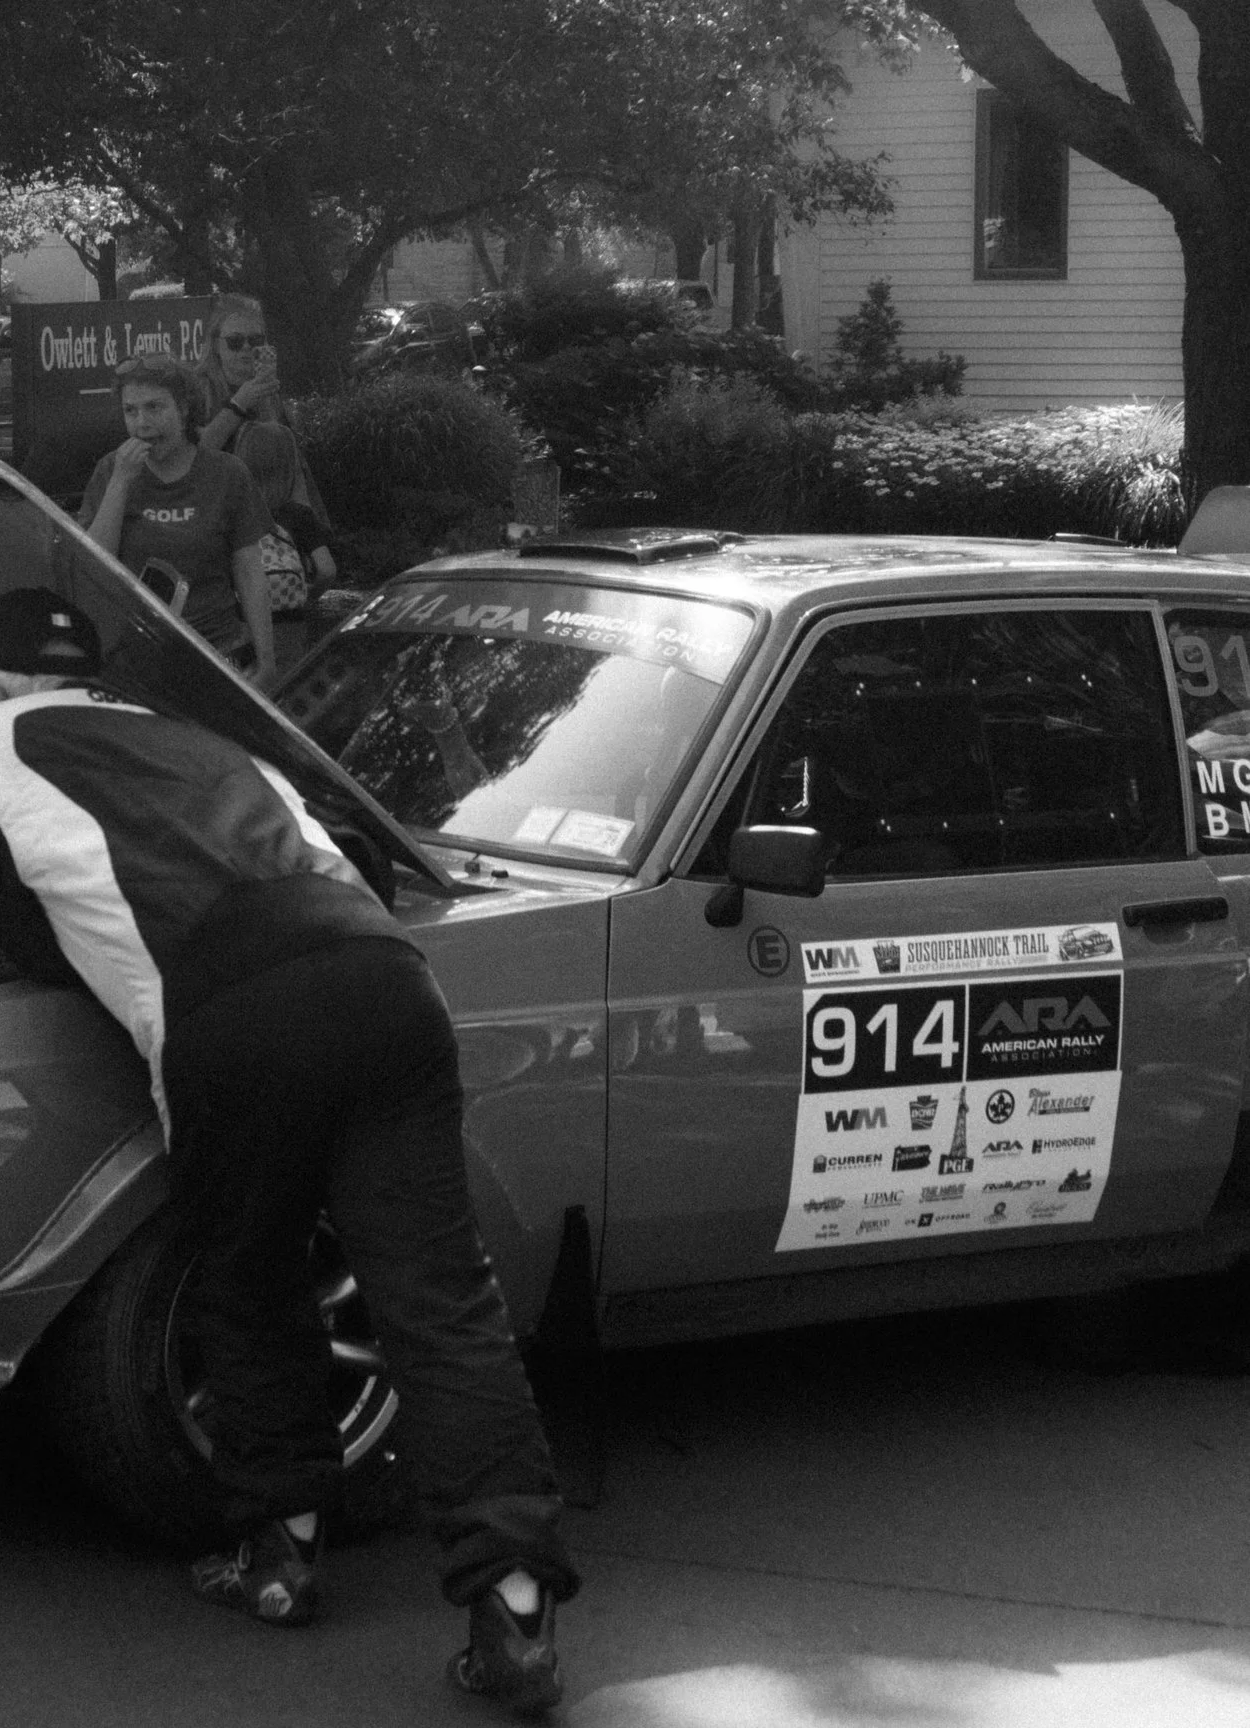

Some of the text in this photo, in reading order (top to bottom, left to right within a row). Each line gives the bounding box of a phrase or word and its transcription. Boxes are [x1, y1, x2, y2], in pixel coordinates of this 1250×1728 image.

[40, 326, 98, 371] Owlett
[103, 325, 118, 366] &
[124, 320, 171, 356] Lewis
[142, 506, 195, 522] GOLF
[364, 594, 449, 627] 914
[432, 603, 530, 632] ARA
[543, 610, 657, 636] AMERICAN
[1196, 760, 1226, 794] M
[1204, 803, 1231, 837] B
[756, 934, 782, 969] E
[805, 946, 860, 971] WM
[907, 936, 1010, 963] SUSQUEHANNOCK
[1012, 933, 1049, 955] TRAIL
[977, 995, 1112, 1036] ARA
[811, 1000, 960, 1077] 914
[981, 1034, 1105, 1054] AMERICAN RALLY
[990, 1048, 1092, 1062] ASSOCIATION
[825, 1106, 887, 1132] WM
[1027, 1095, 1096, 1117] Alexander
[828, 1153, 883, 1166] CURREN
[863, 1189, 905, 1205] UPMC
